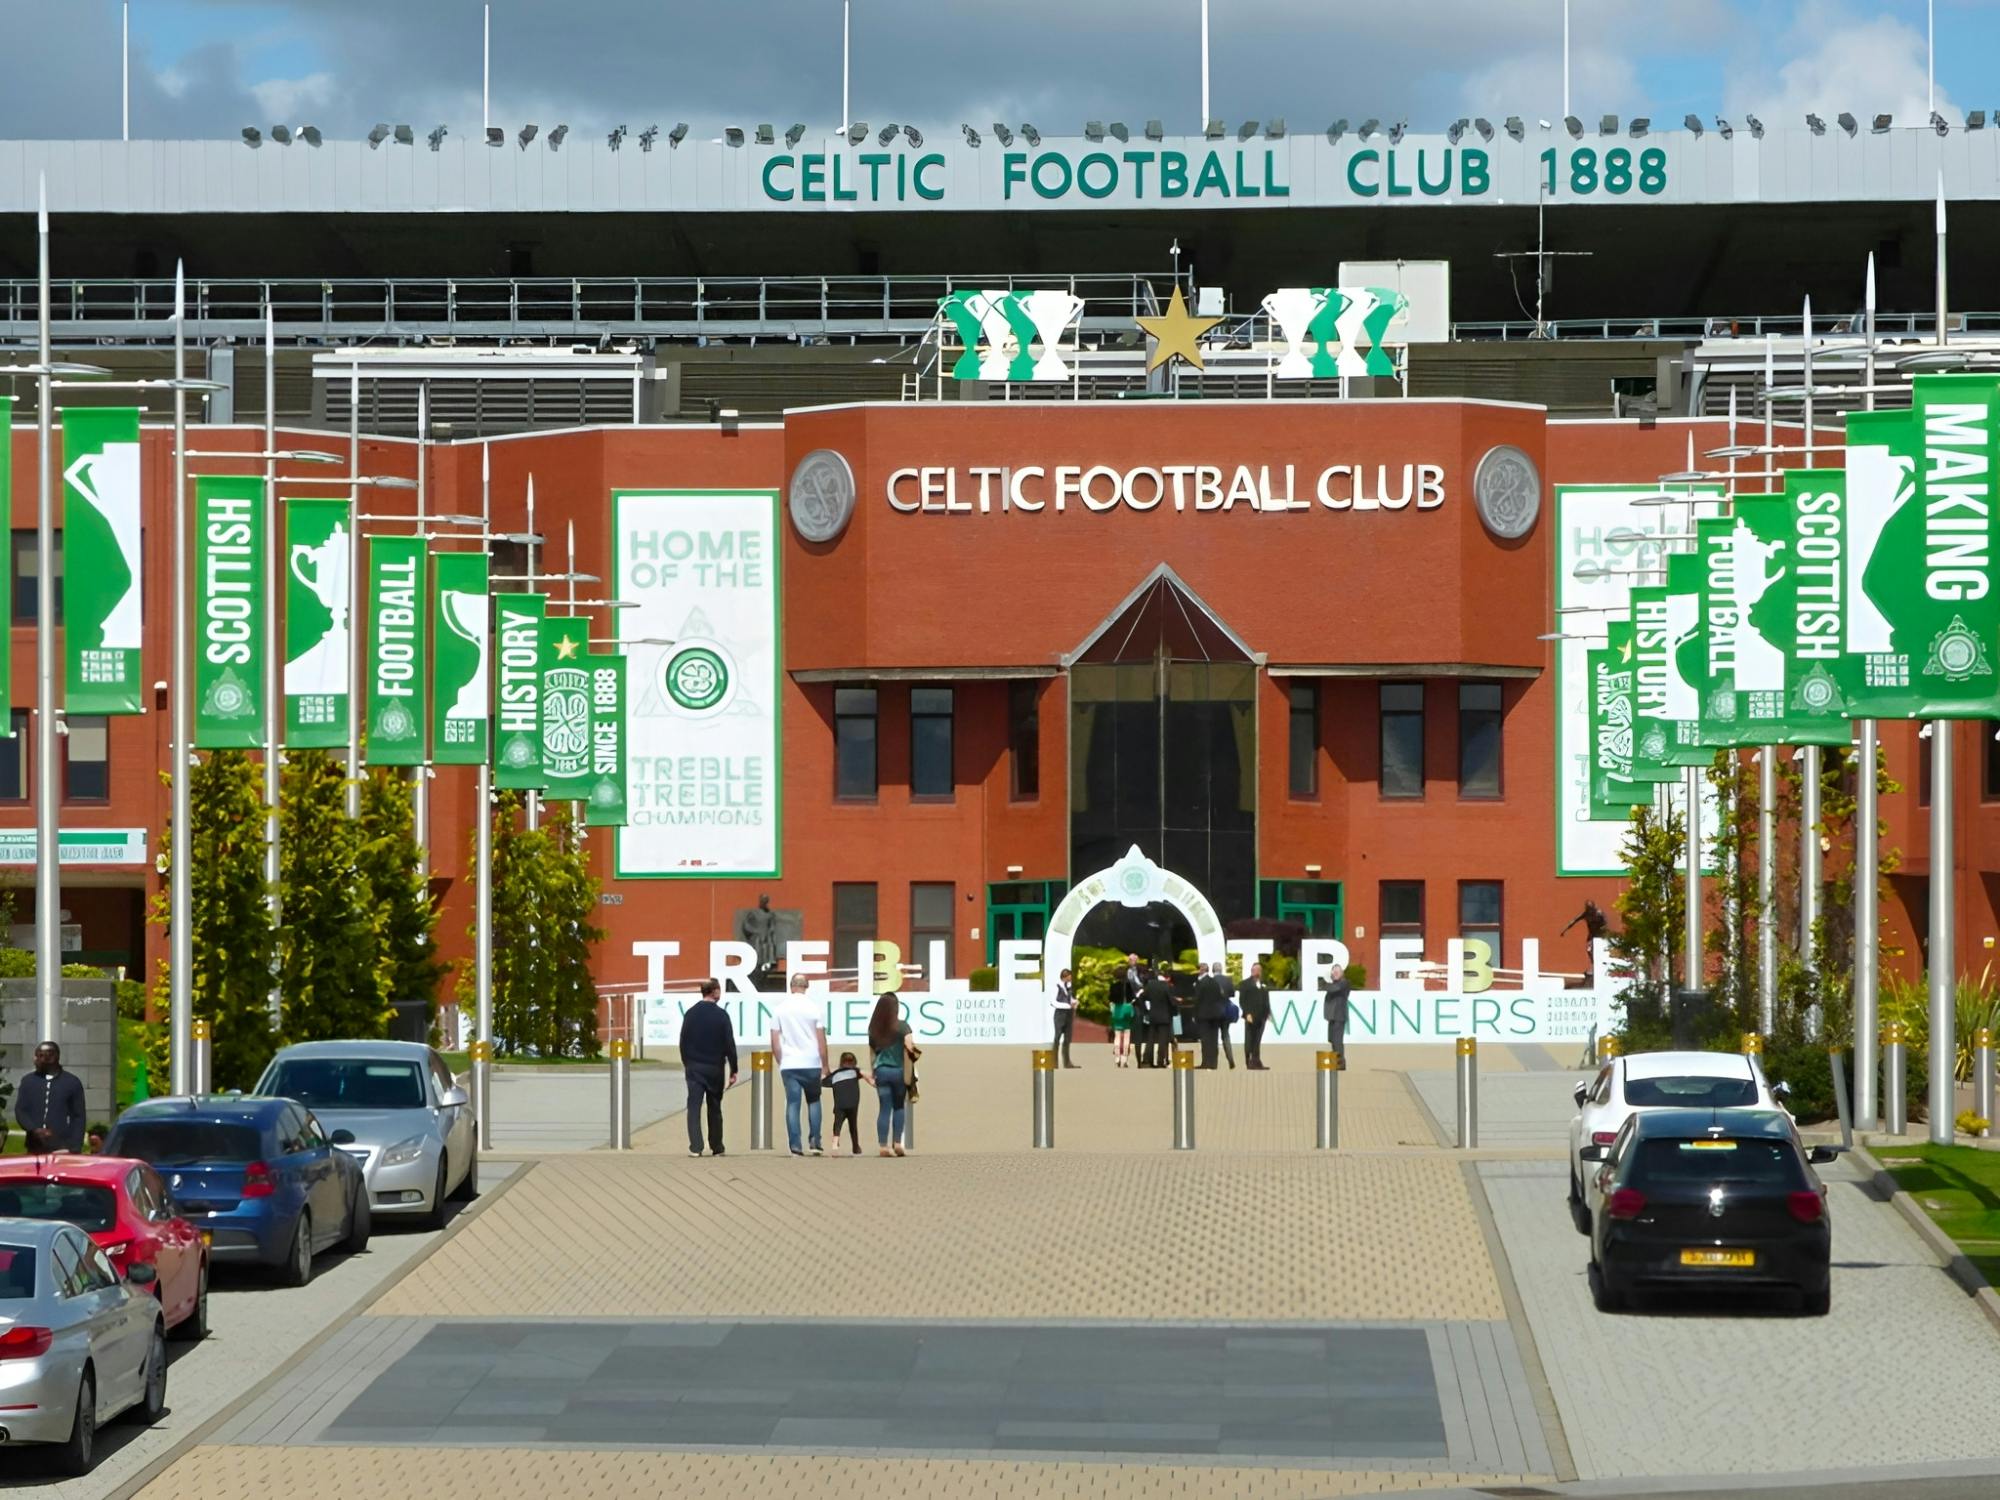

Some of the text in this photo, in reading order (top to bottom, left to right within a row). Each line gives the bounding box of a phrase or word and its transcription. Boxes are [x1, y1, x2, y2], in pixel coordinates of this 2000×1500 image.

[762, 147, 1667, 202] CELTIC FOOTBALL CLUB 1888
[886, 464, 1446, 513] CELTIC FOOTBALL CLUB
[1925, 404, 1989, 600] MAKING
[630, 530, 761, 560] HOME
[206, 498, 251, 664] SCOTTISH
[630, 562, 763, 589] OF THE
[1796, 492, 1841, 659] SCOTTISH
[378, 556, 416, 696] FOOTBALL
[501, 610, 538, 731] HISTORY
[593, 668, 618, 774] SINCE 1888
[632, 756, 763, 781] TREBLE
[632, 783, 763, 808] TREBLE
[632, 940, 1043, 993] TREBLE
[1267, 998, 1536, 1036] WNNERS
